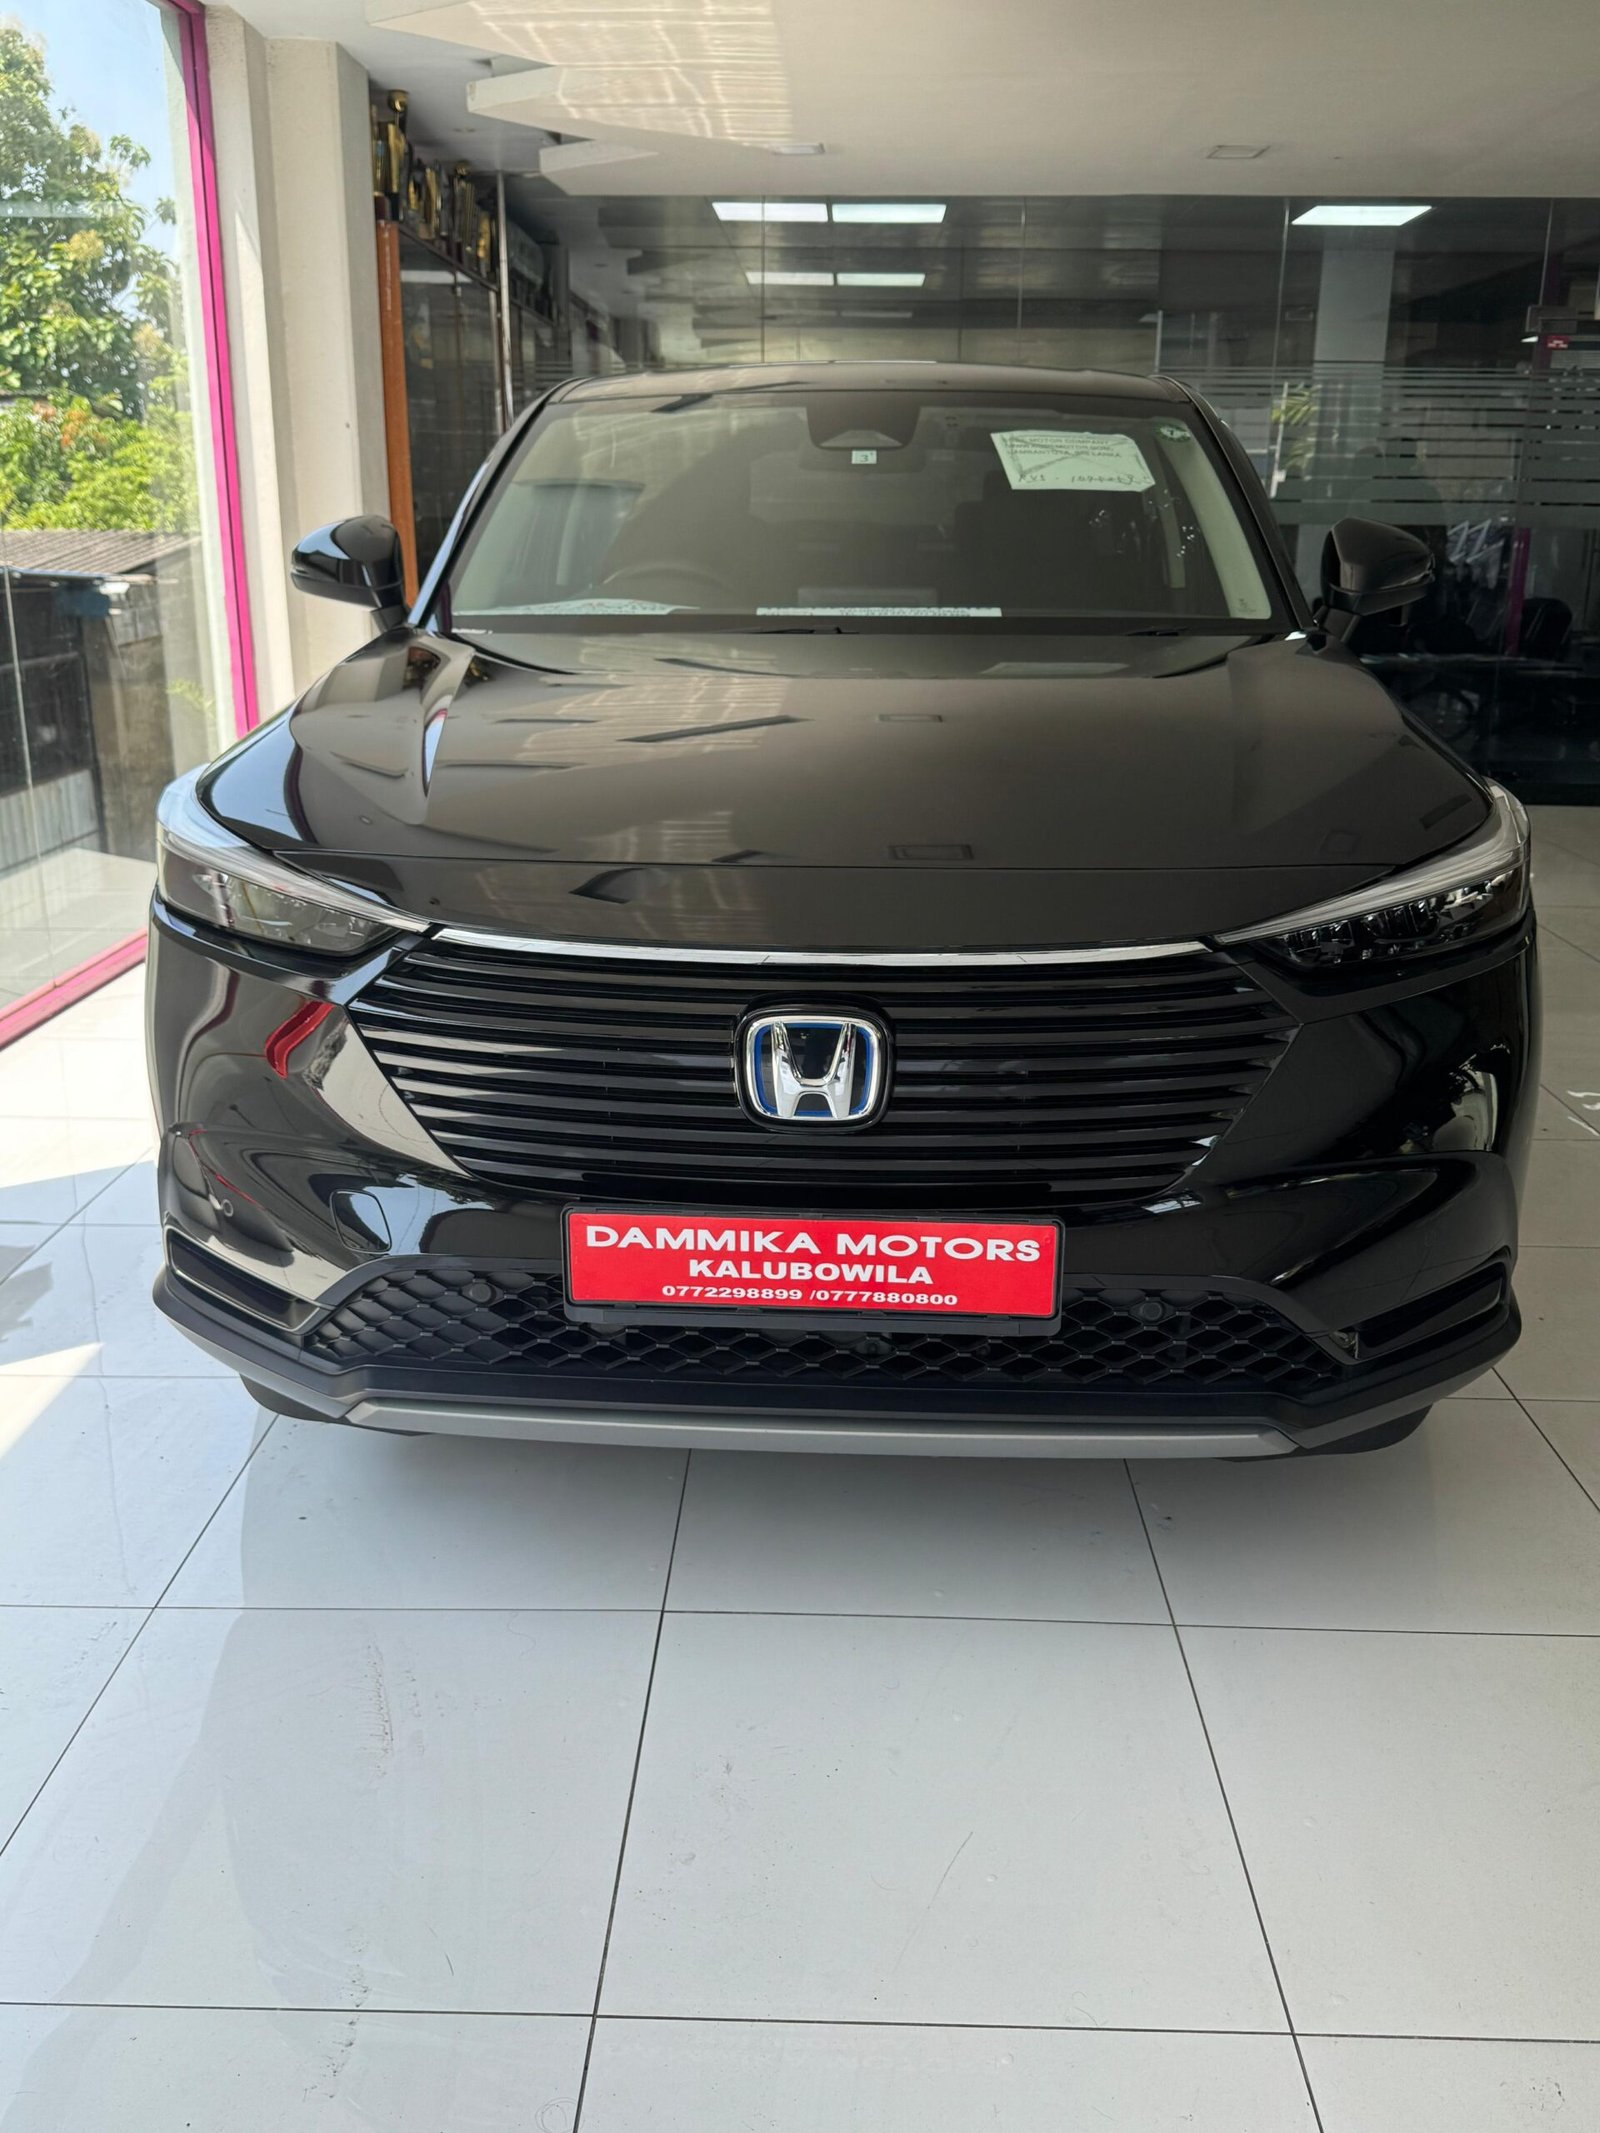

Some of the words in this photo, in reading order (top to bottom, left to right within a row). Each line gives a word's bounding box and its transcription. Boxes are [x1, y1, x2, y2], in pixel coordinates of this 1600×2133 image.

[586, 1225, 822, 1255] DAMMIKA
[836, 1233, 1041, 1262] MOTORS
[689, 1259, 934, 1285] KALUBOWILA
[661, 1284, 803, 1301] 0772298899
[809, 1289, 958, 1306] /0777880800
